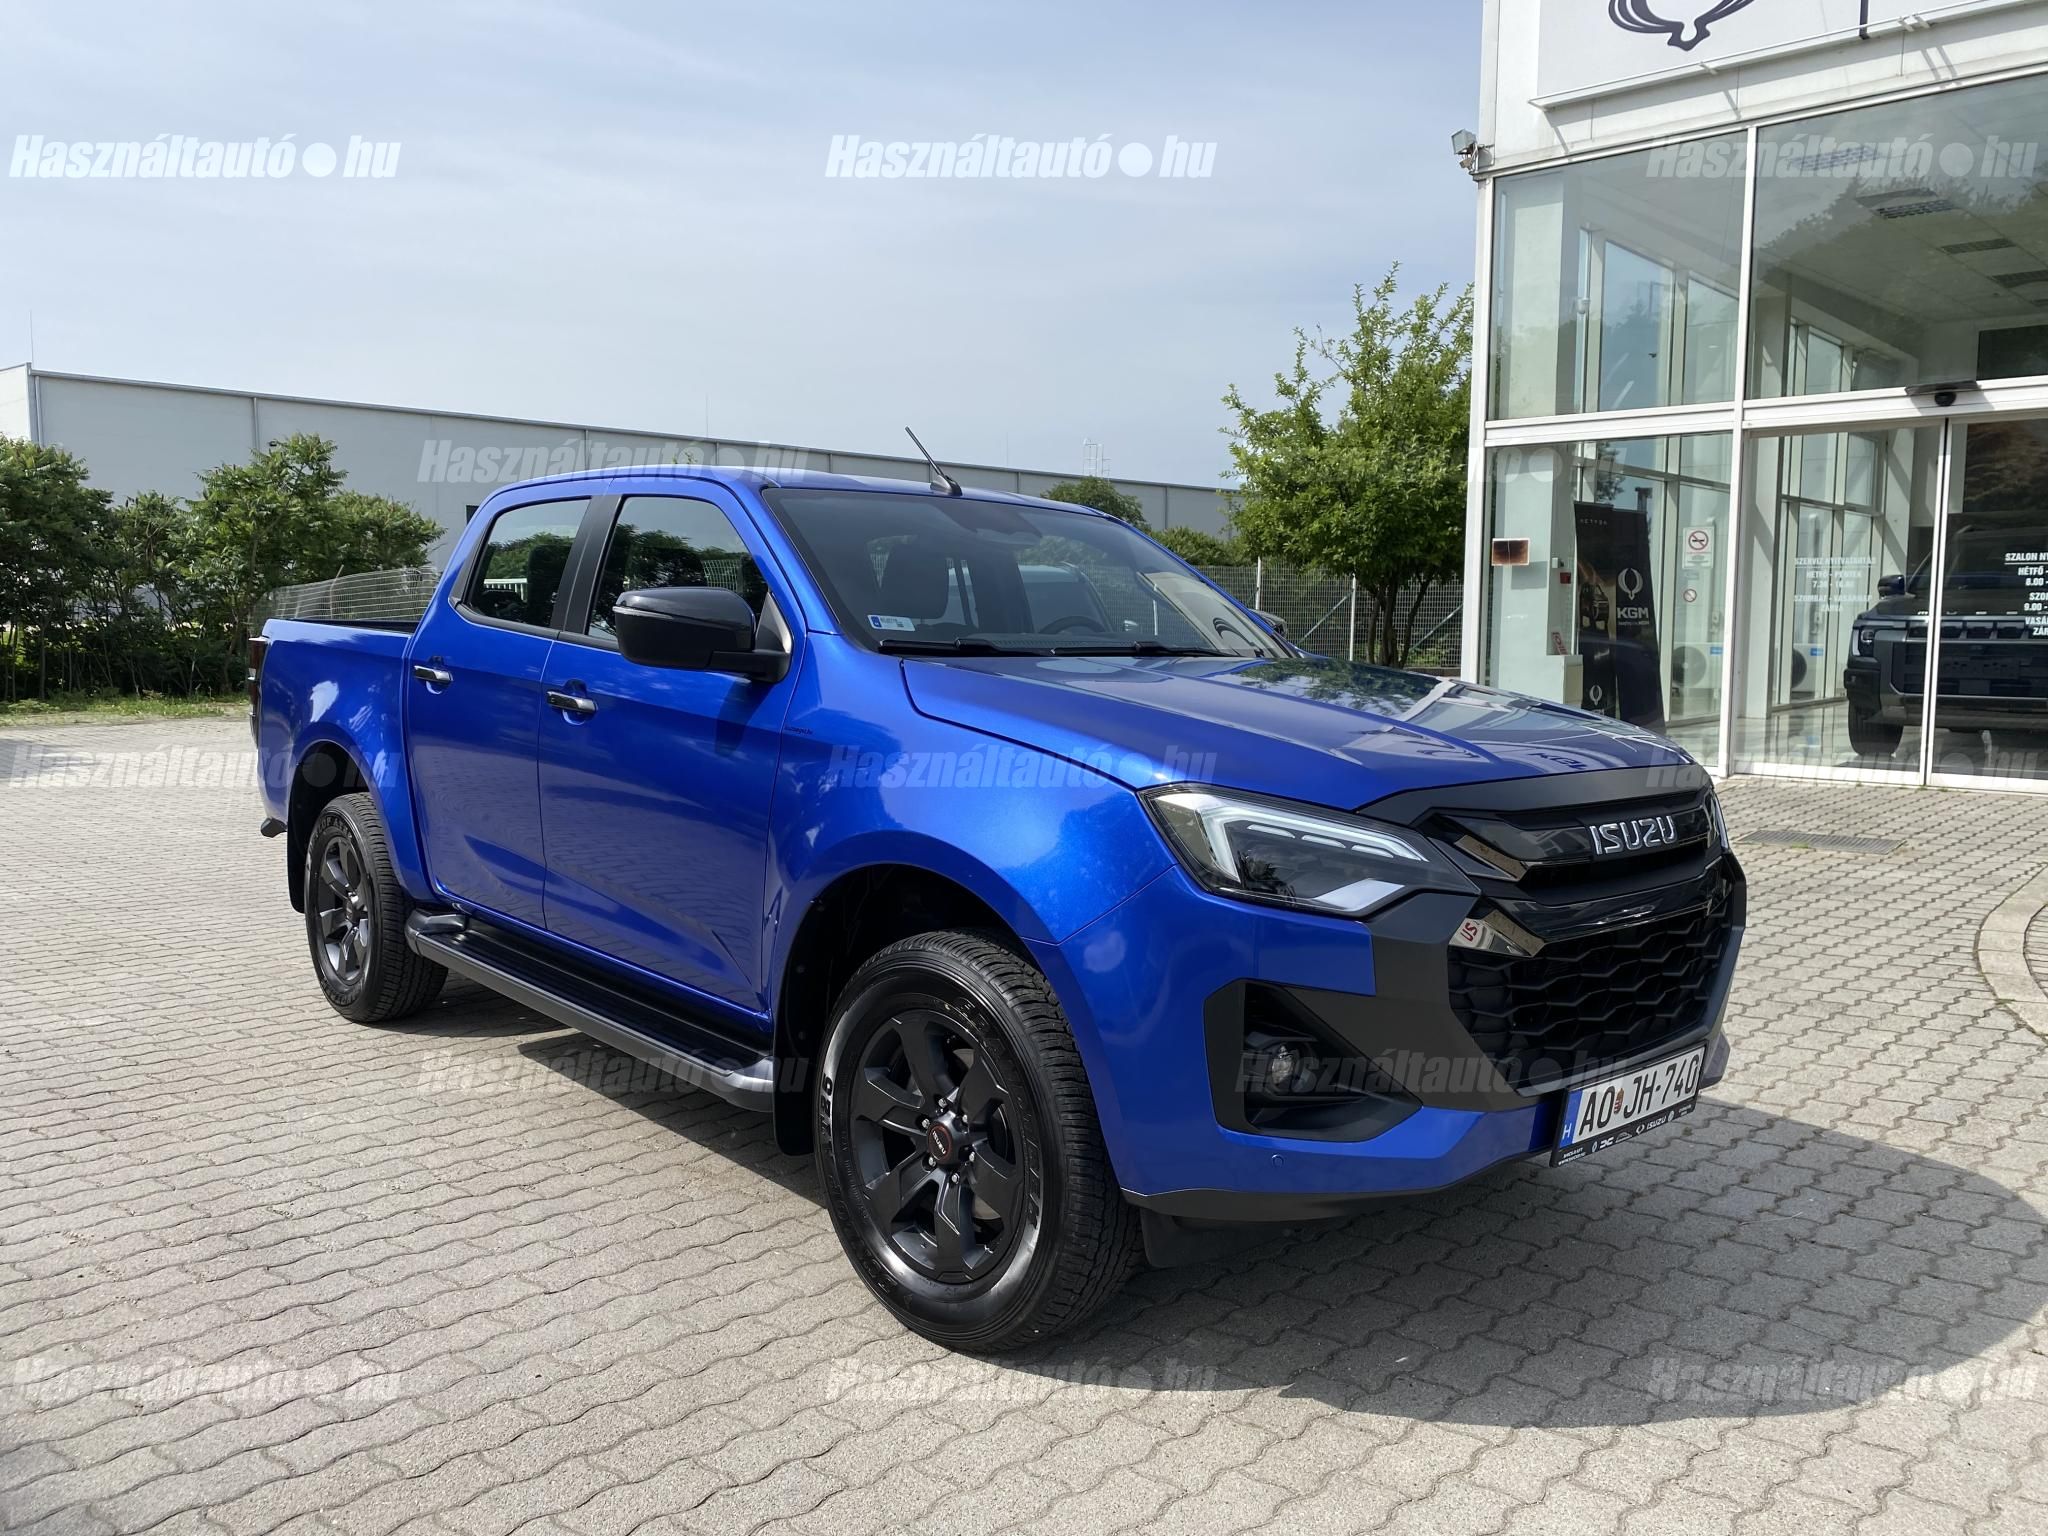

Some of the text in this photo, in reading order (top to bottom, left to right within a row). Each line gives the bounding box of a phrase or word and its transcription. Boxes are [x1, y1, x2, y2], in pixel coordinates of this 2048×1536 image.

[2005, 552, 2038, 562] SZALON
[2018, 566, 2044, 576] HÉTFŐ
[1616, 607, 1649, 619] KGM
[1589, 814, 1678, 856] ISUZU
[1578, 1054, 1700, 1136] AO JH-740
[1646, 1115, 1667, 1131] ISUZU
[1562, 1122, 1572, 1141] H
